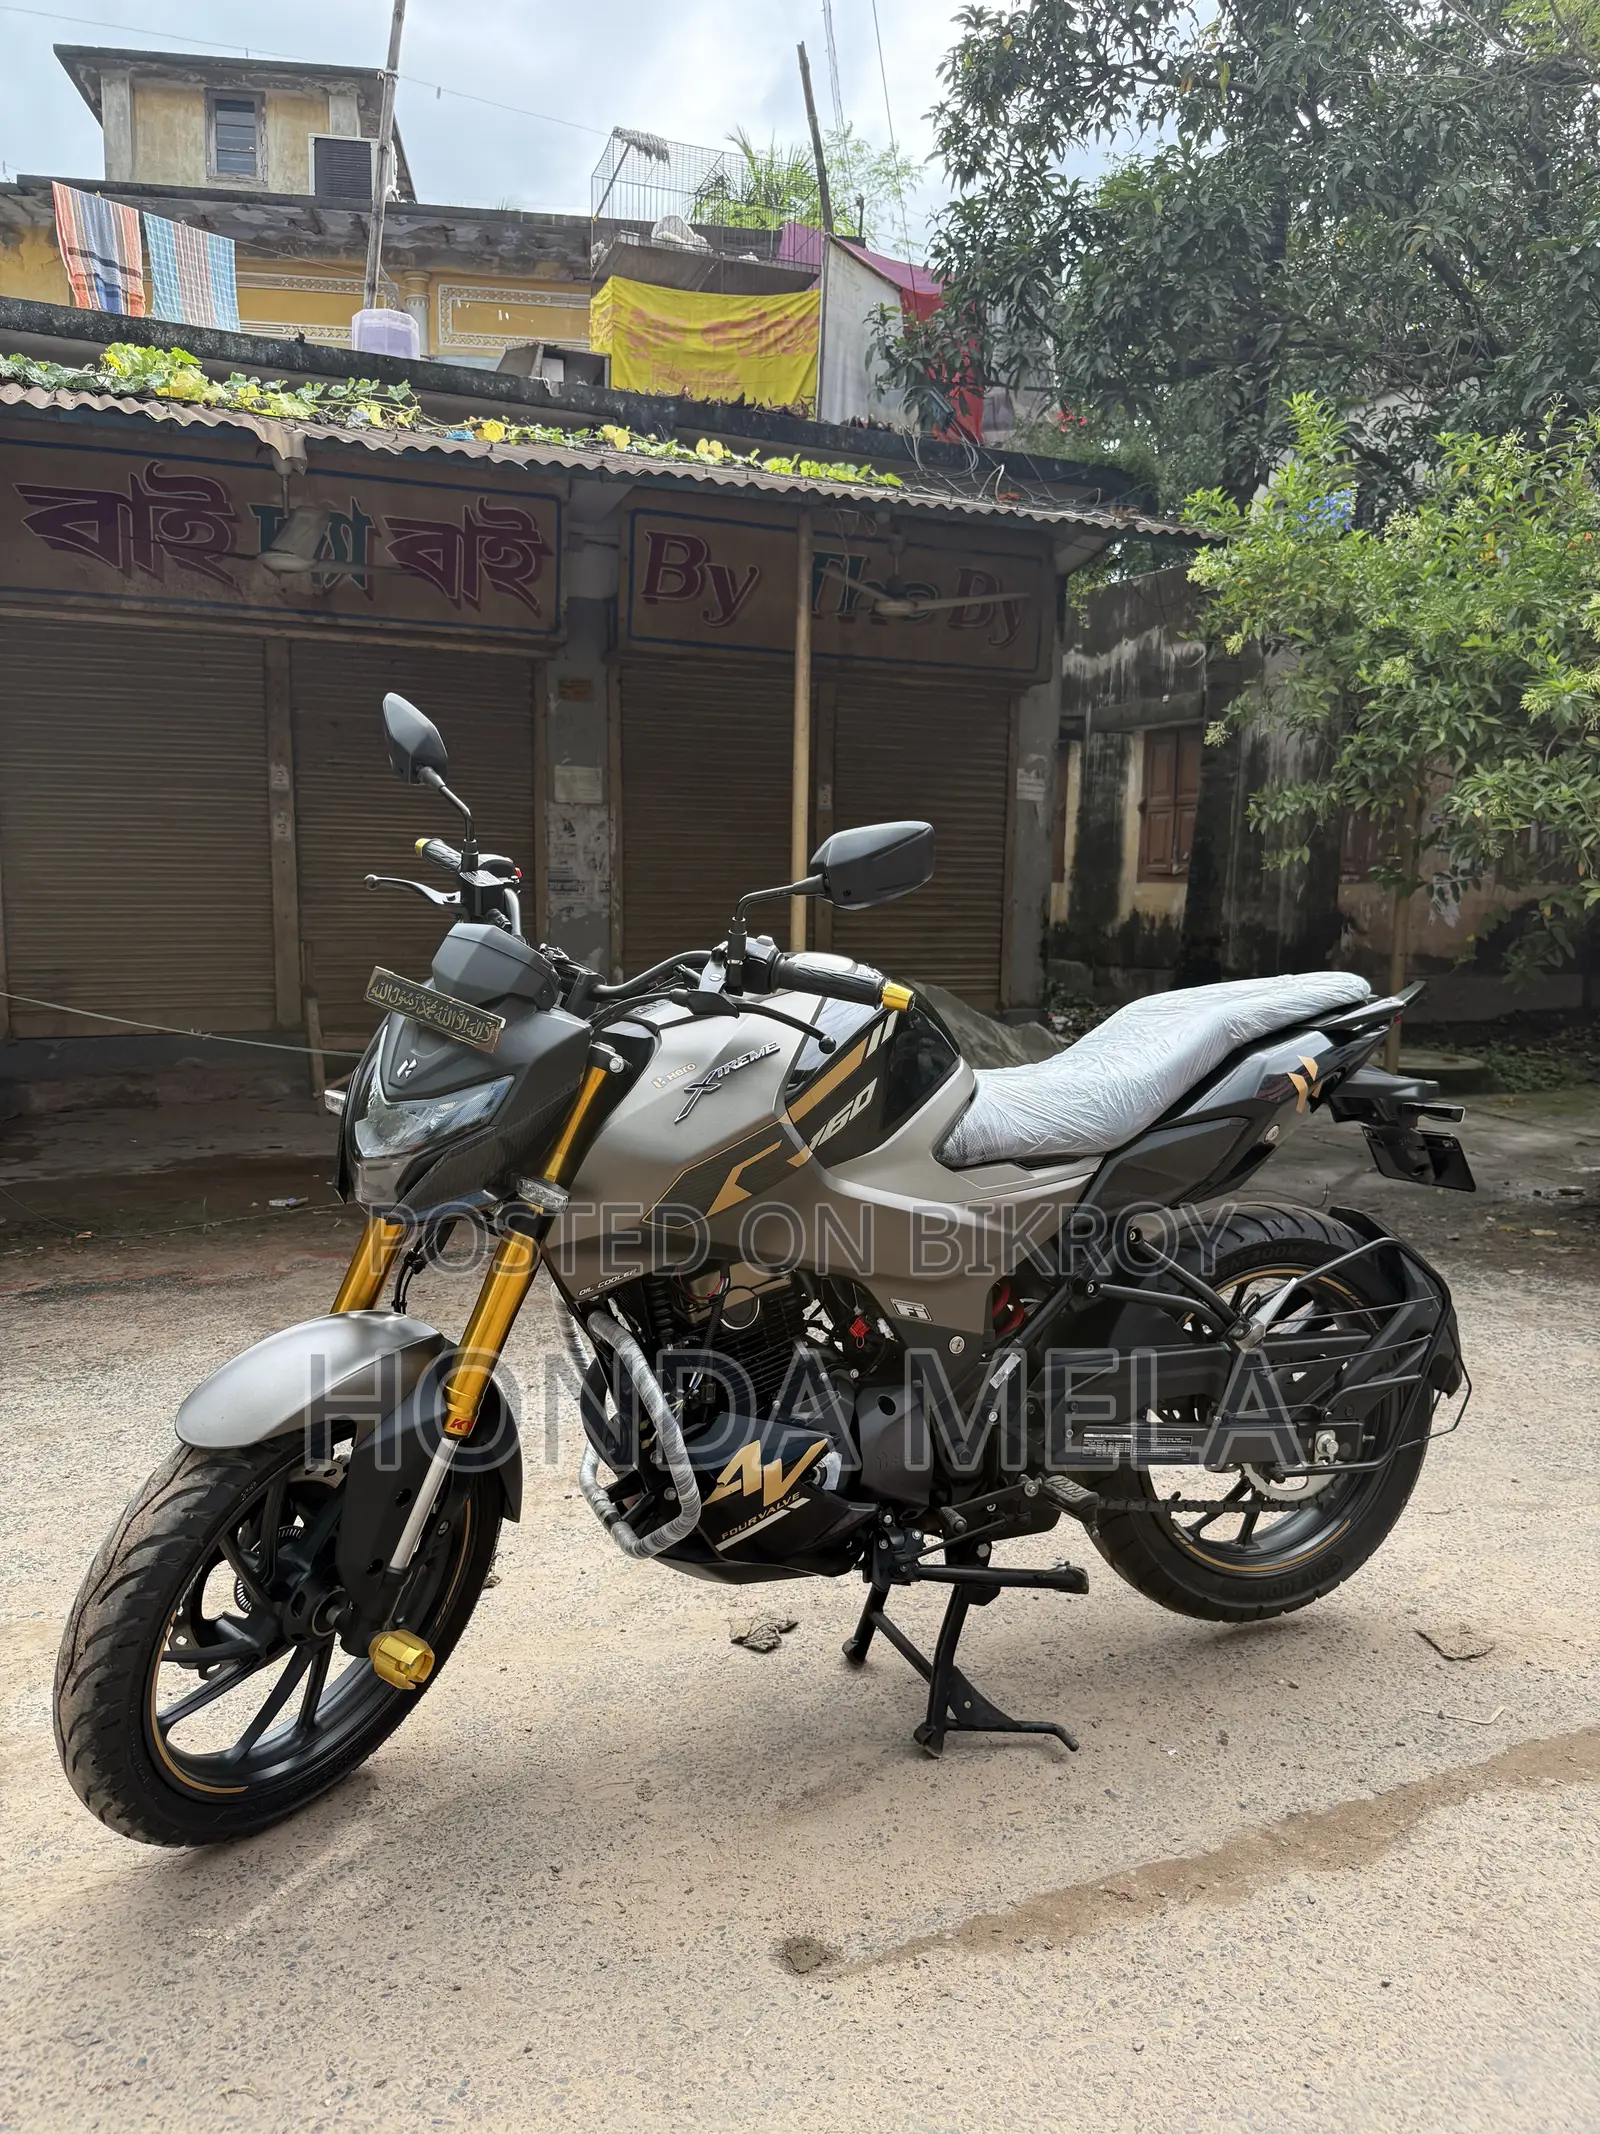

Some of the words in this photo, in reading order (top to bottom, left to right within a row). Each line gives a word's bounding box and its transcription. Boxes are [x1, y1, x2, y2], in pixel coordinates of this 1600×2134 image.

[13, 460, 241, 592] বাই
[384, 497, 549, 613] বাই
[639, 529, 760, 628] By
[946, 567, 1026, 649] By
[666, 1061, 698, 1082] Hero
[673, 1040, 781, 1126] XTREME
[807, 1077, 878, 1152] 160
[578, 1286, 595, 1296] OIL
[597, 1268, 638, 1289] COOLER
